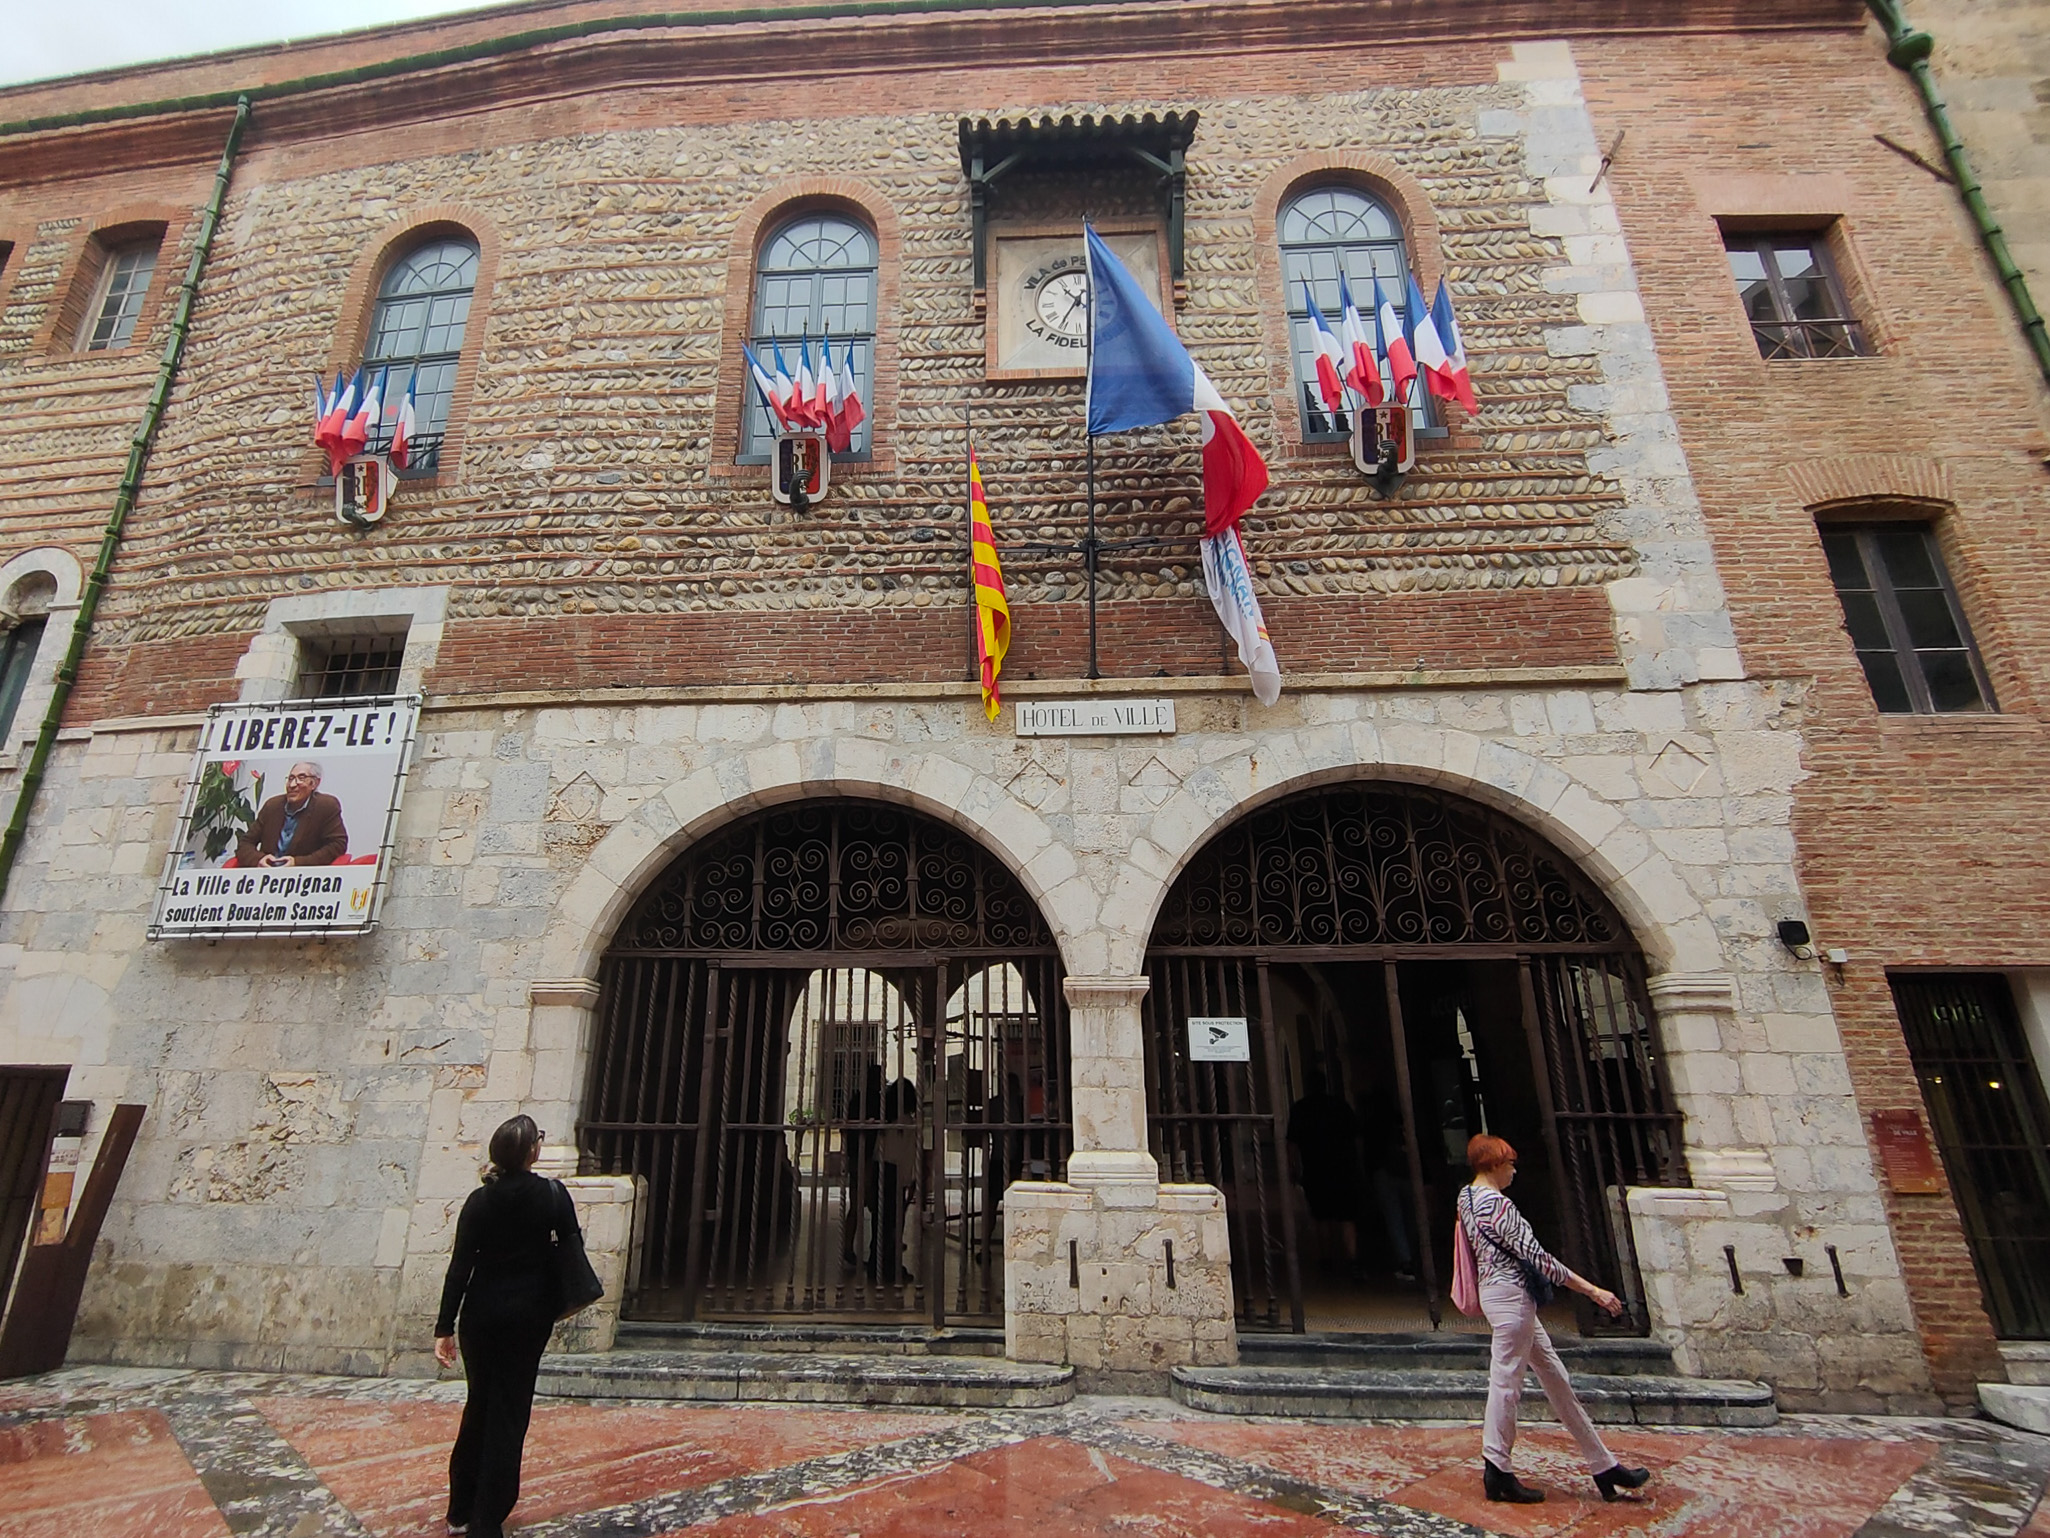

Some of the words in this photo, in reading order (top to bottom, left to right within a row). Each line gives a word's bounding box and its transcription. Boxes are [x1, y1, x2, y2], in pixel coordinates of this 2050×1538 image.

[1024, 268, 1050, 289] VILA
[1051, 259, 1067, 270] de
[1025, 319, 1045, 338] LA
[1023, 708, 1083, 728] HOTEL
[1091, 716, 1108, 727] DE
[1113, 706, 1168, 726] VILLE
[220, 713, 379, 752] LIBEREZ-LE
[171, 877, 189, 896] La
[196, 876, 230, 896] Ville
[236, 875, 254, 895] de
[259, 874, 342, 898] Perpignan
[165, 904, 224, 923] soutient
[227, 902, 287, 922] Boualem
[290, 901, 340, 921] Sansal
